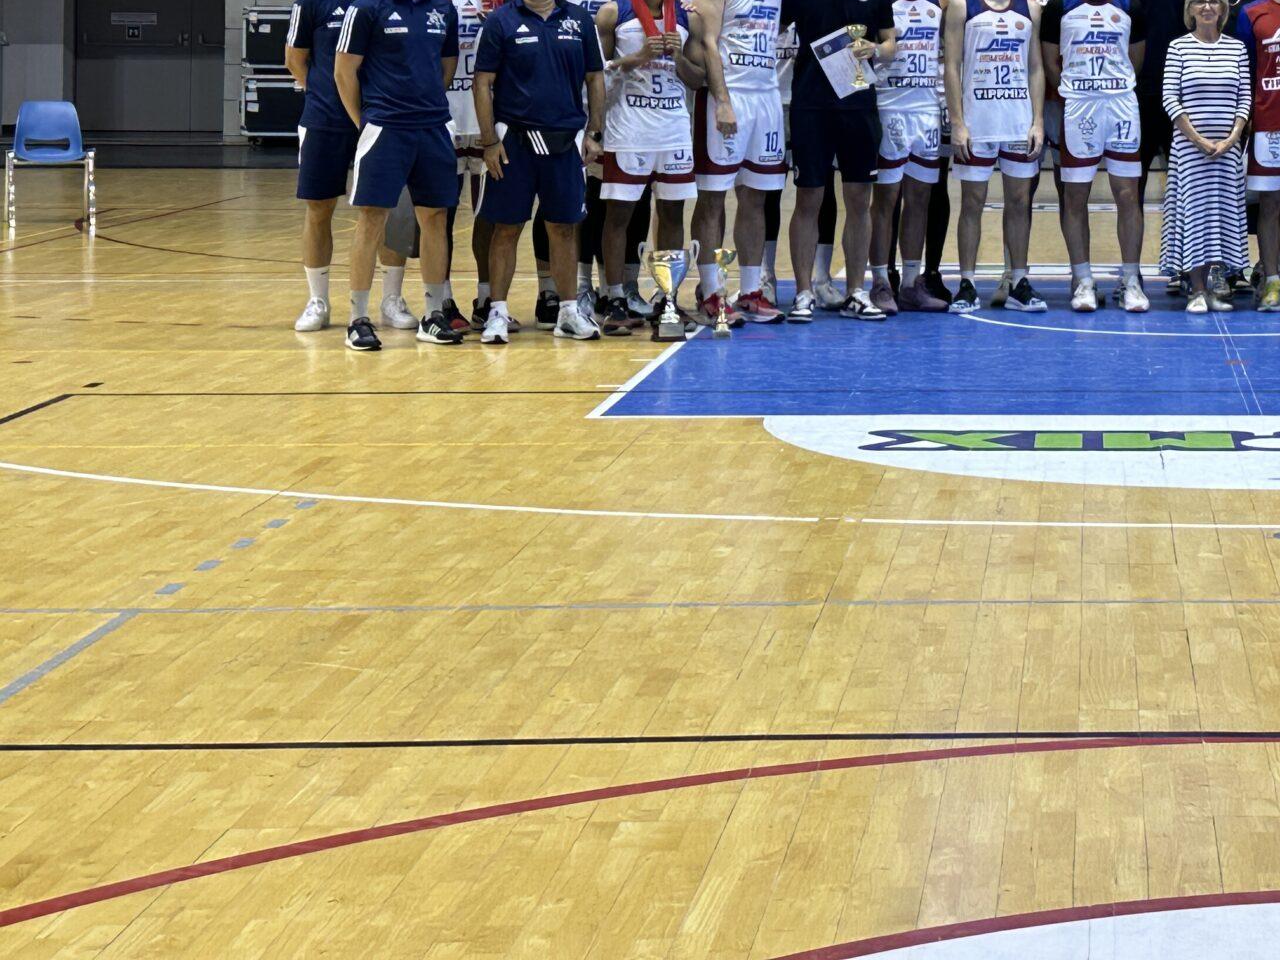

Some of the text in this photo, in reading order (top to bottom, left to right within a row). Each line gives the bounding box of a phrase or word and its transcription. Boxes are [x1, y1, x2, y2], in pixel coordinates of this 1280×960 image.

[753, 33, 767, 53] 10
[908, 54, 926, 73] 30
[1089, 57, 1104, 76] 17
[652, 74, 662, 94] 5
[994, 65, 1010, 84] 12
[1072, 78, 1128, 90] TIPPMIX
[626, 95, 683, 109] TIPPMIX
[974, 88, 1027, 100] TIPPMIX
[925, 129, 938, 148] 30
[1115, 121, 1131, 139] 17
[765, 132, 778, 151] 10
